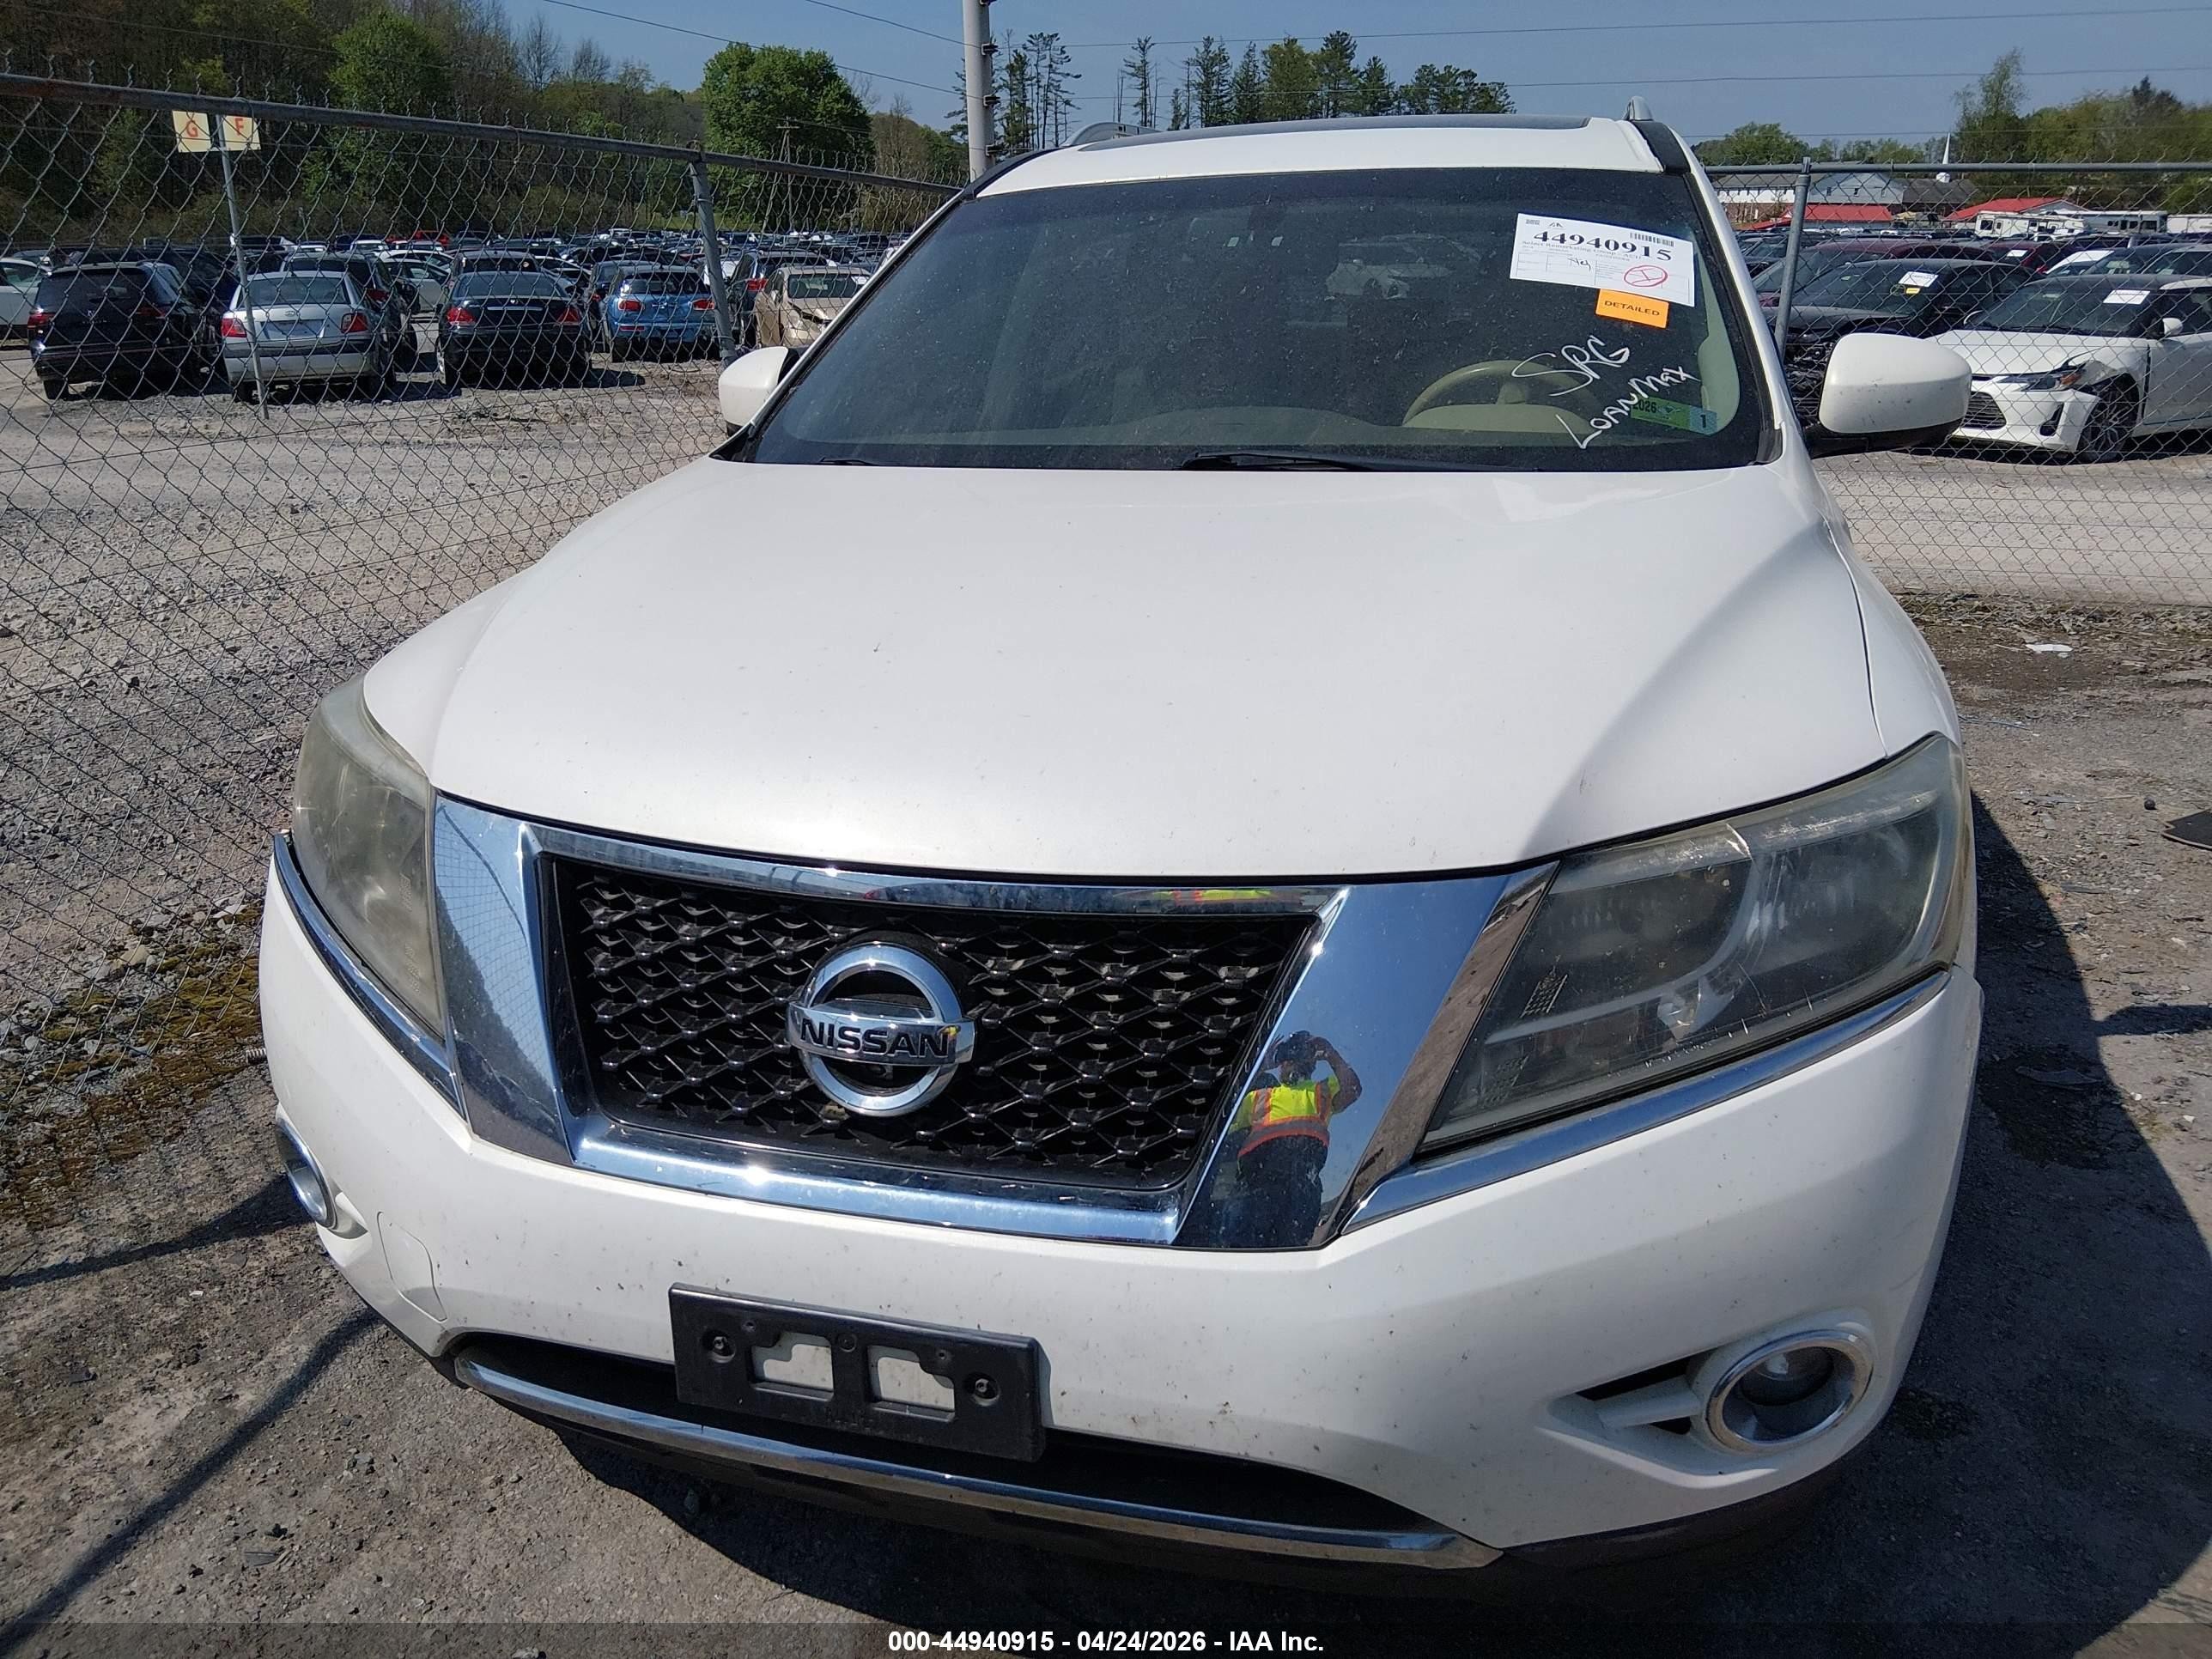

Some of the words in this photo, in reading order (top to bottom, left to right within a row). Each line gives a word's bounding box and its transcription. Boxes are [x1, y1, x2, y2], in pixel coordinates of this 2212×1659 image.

[185, 119, 199, 138] G
[234, 118, 244, 137] F
[1534, 230, 1672, 261] 44940915
[1603, 301, 1661, 316] DETAILED
[1511, 335, 1631, 397] SRG
[1699, 414, 1707, 428] 1
[799, 1018, 950, 1060] NISSAN
